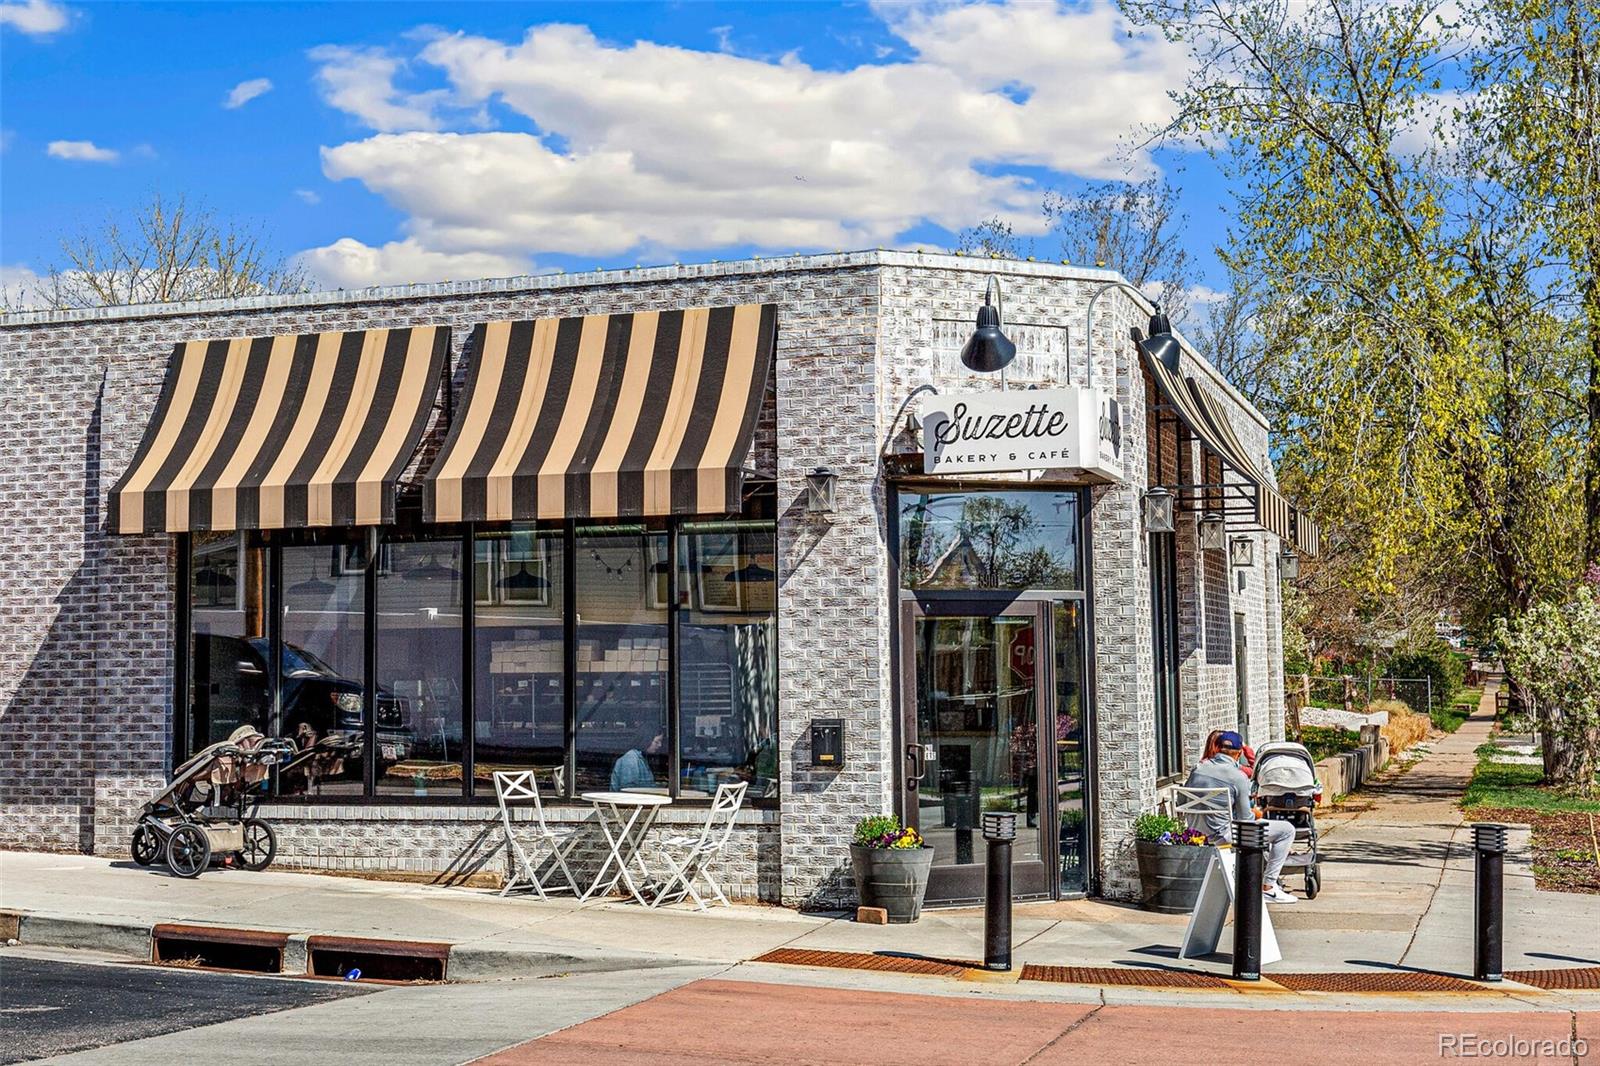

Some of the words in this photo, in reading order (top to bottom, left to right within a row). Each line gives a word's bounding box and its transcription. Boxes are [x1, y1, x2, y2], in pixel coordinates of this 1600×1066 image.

[935, 402, 1068, 451] Suzette
[934, 453, 997, 464] BAKERY
[1009, 451, 1017, 461] &
[1028, 447, 1069, 460] CAFÉ
